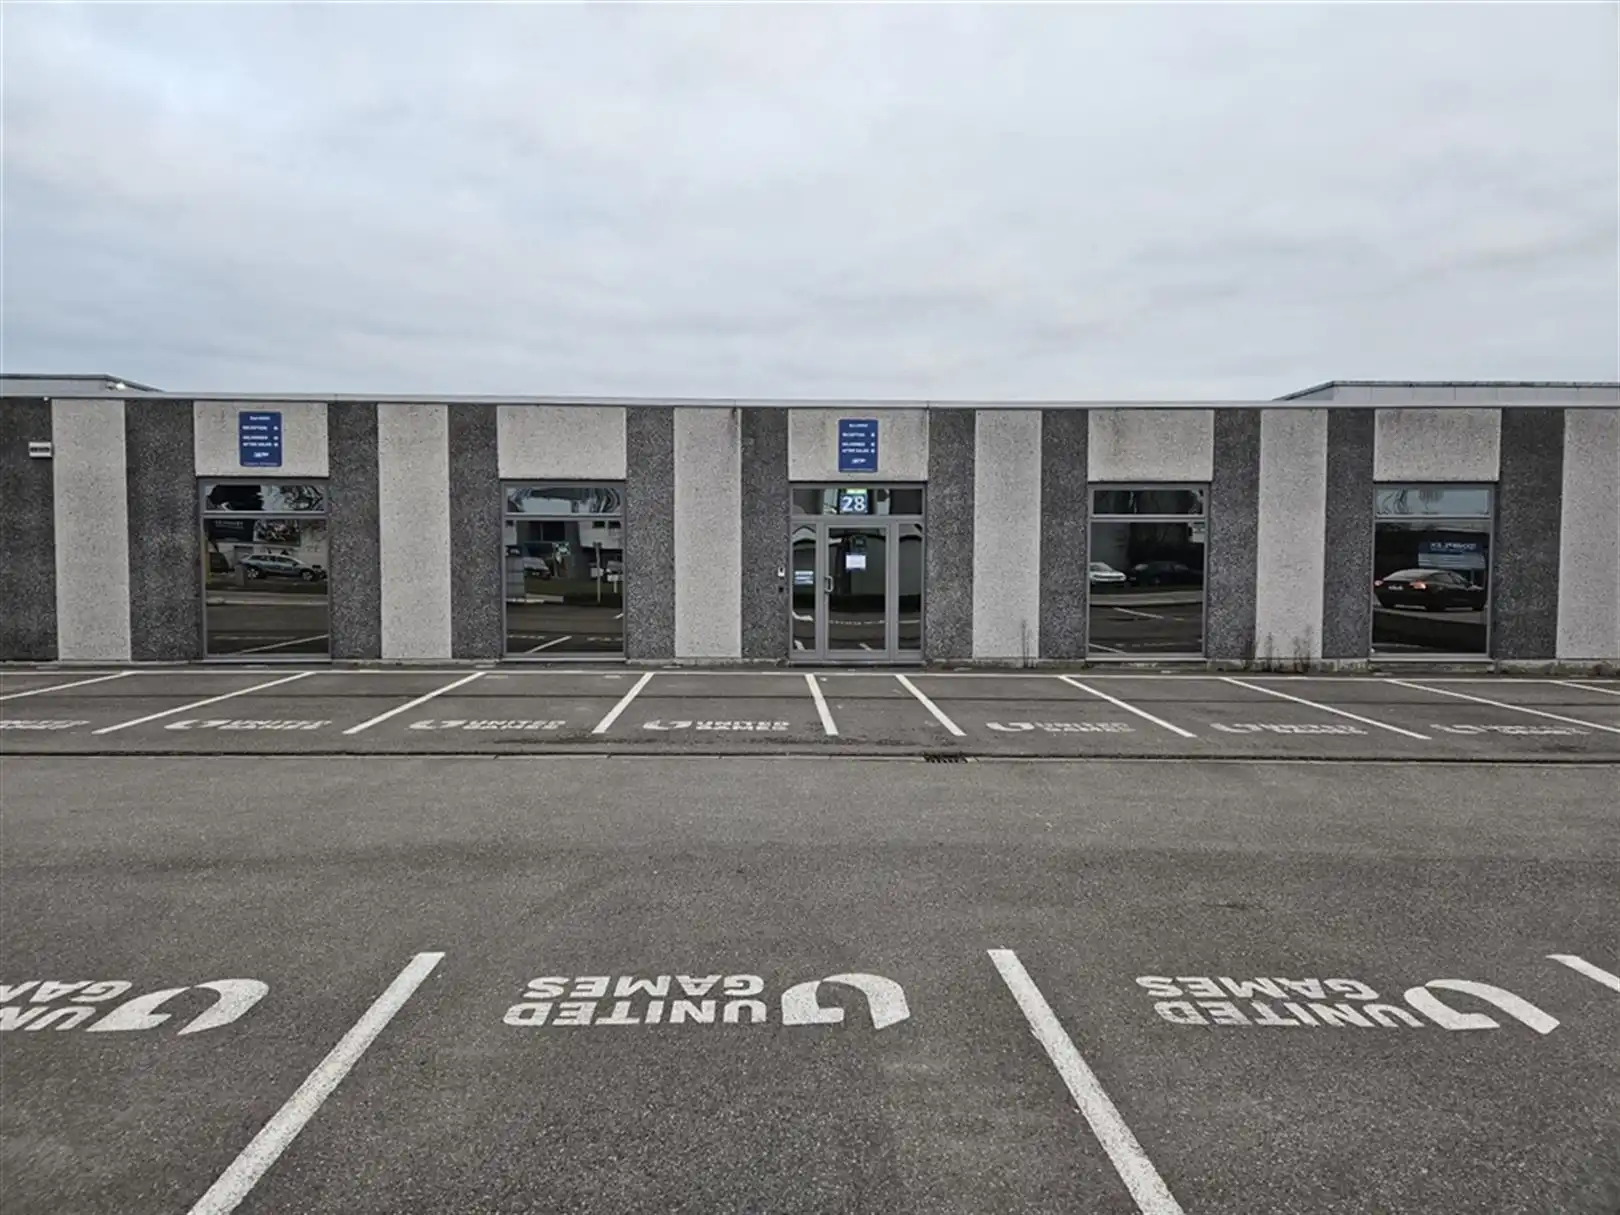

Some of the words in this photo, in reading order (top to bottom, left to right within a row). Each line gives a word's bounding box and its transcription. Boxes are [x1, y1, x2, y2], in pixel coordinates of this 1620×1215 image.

[842, 495, 866, 512] 28
[522, 974, 765, 998] GAMES
[1135, 976, 1380, 1001] GAMES
[502, 999, 767, 1027] UNITED
[1153, 1001, 1426, 1028] UNITED
